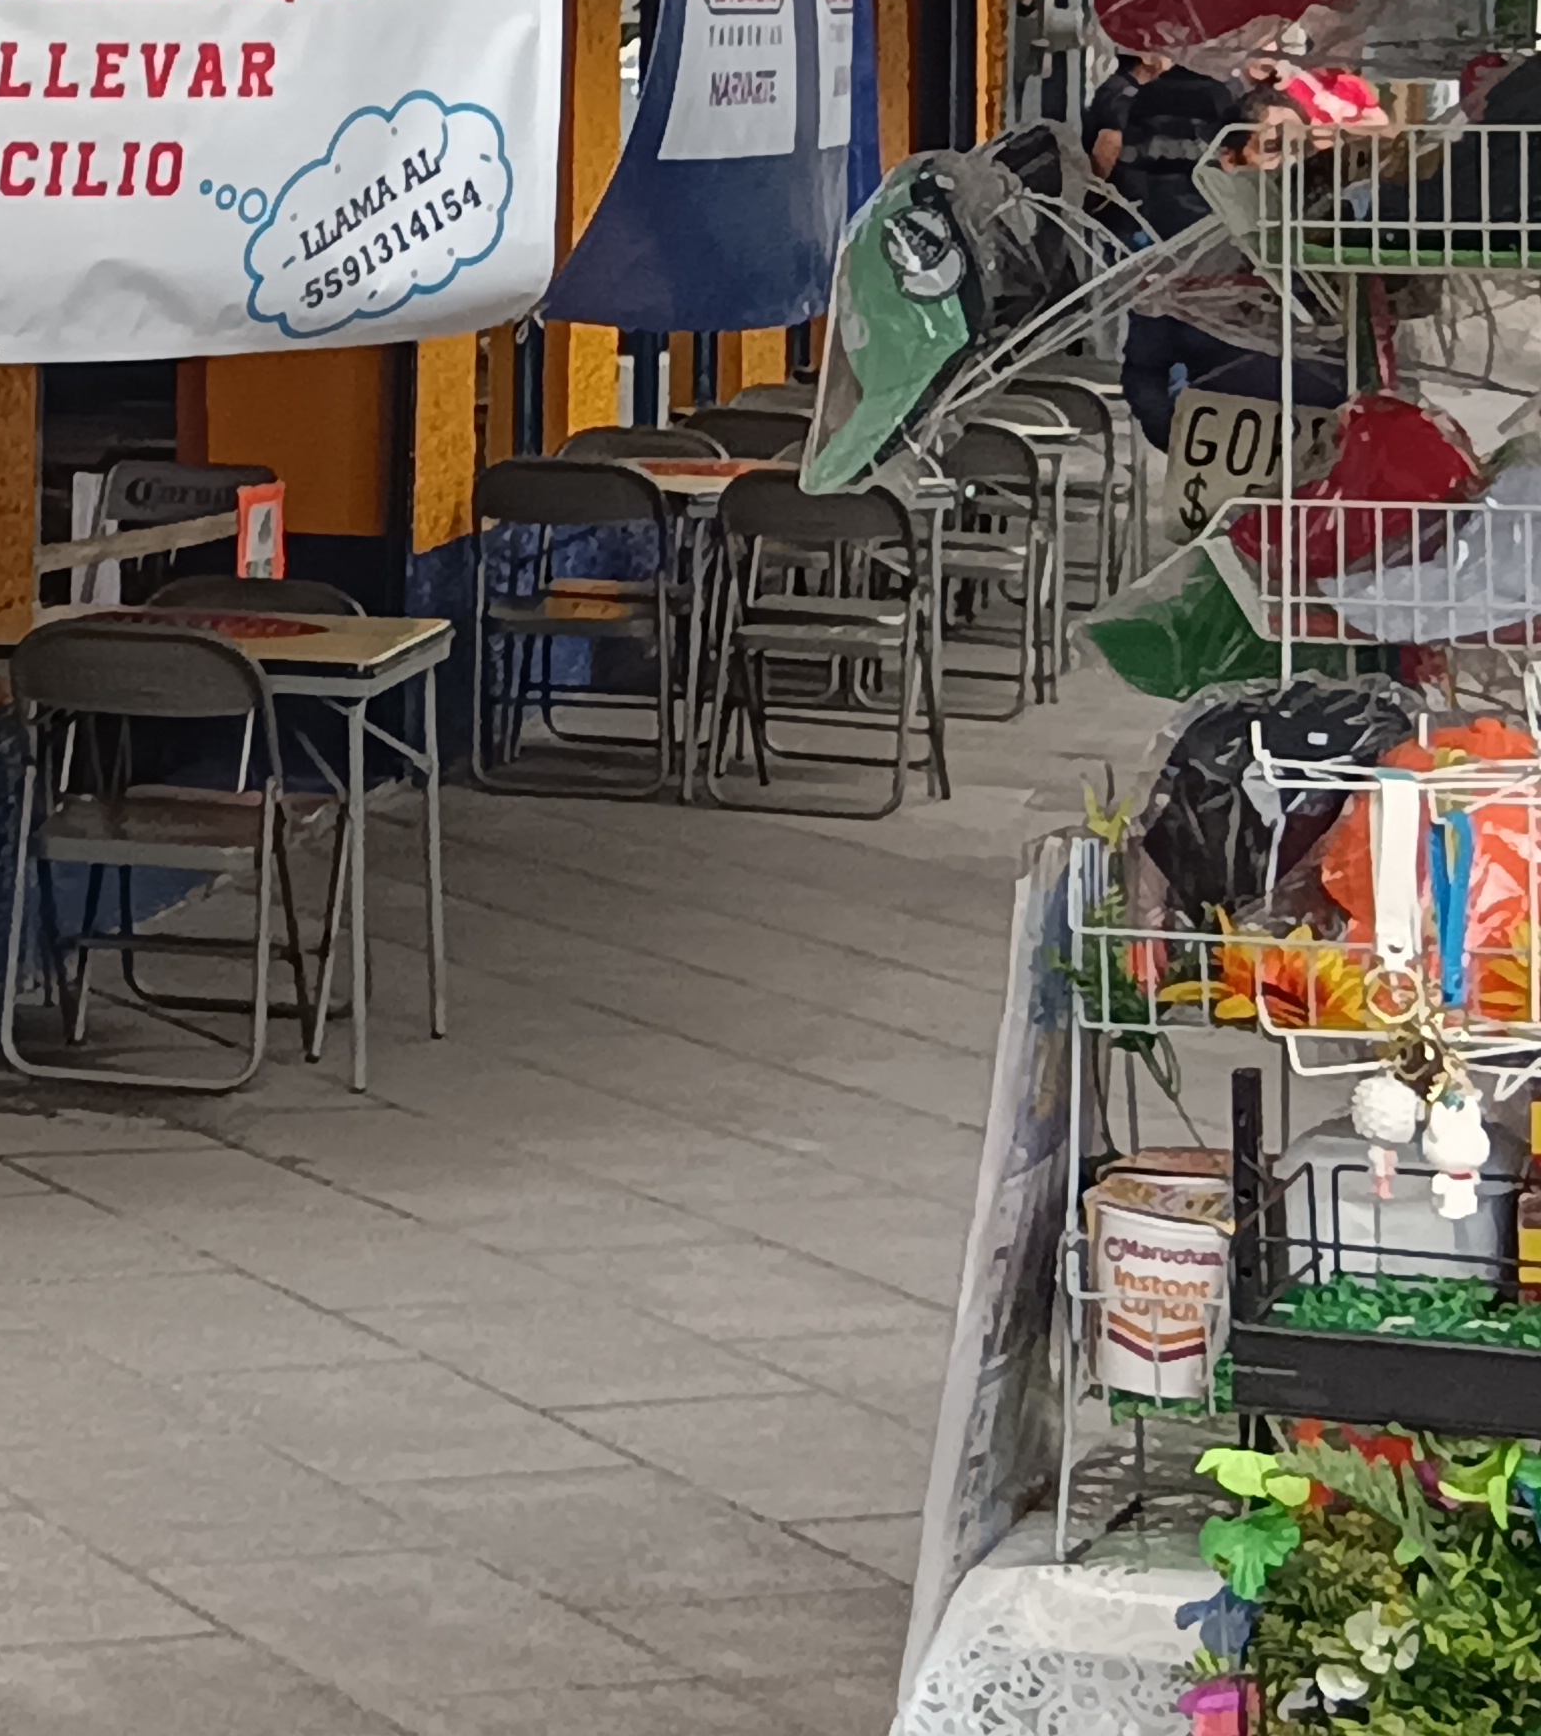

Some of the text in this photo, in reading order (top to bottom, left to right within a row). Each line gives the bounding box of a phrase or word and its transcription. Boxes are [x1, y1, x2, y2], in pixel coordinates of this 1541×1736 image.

[300, 148, 441, 260] LLAMA AL
[305, 177, 482, 308] 5591314154
[1114, 1265, 1210, 1298] Instant
